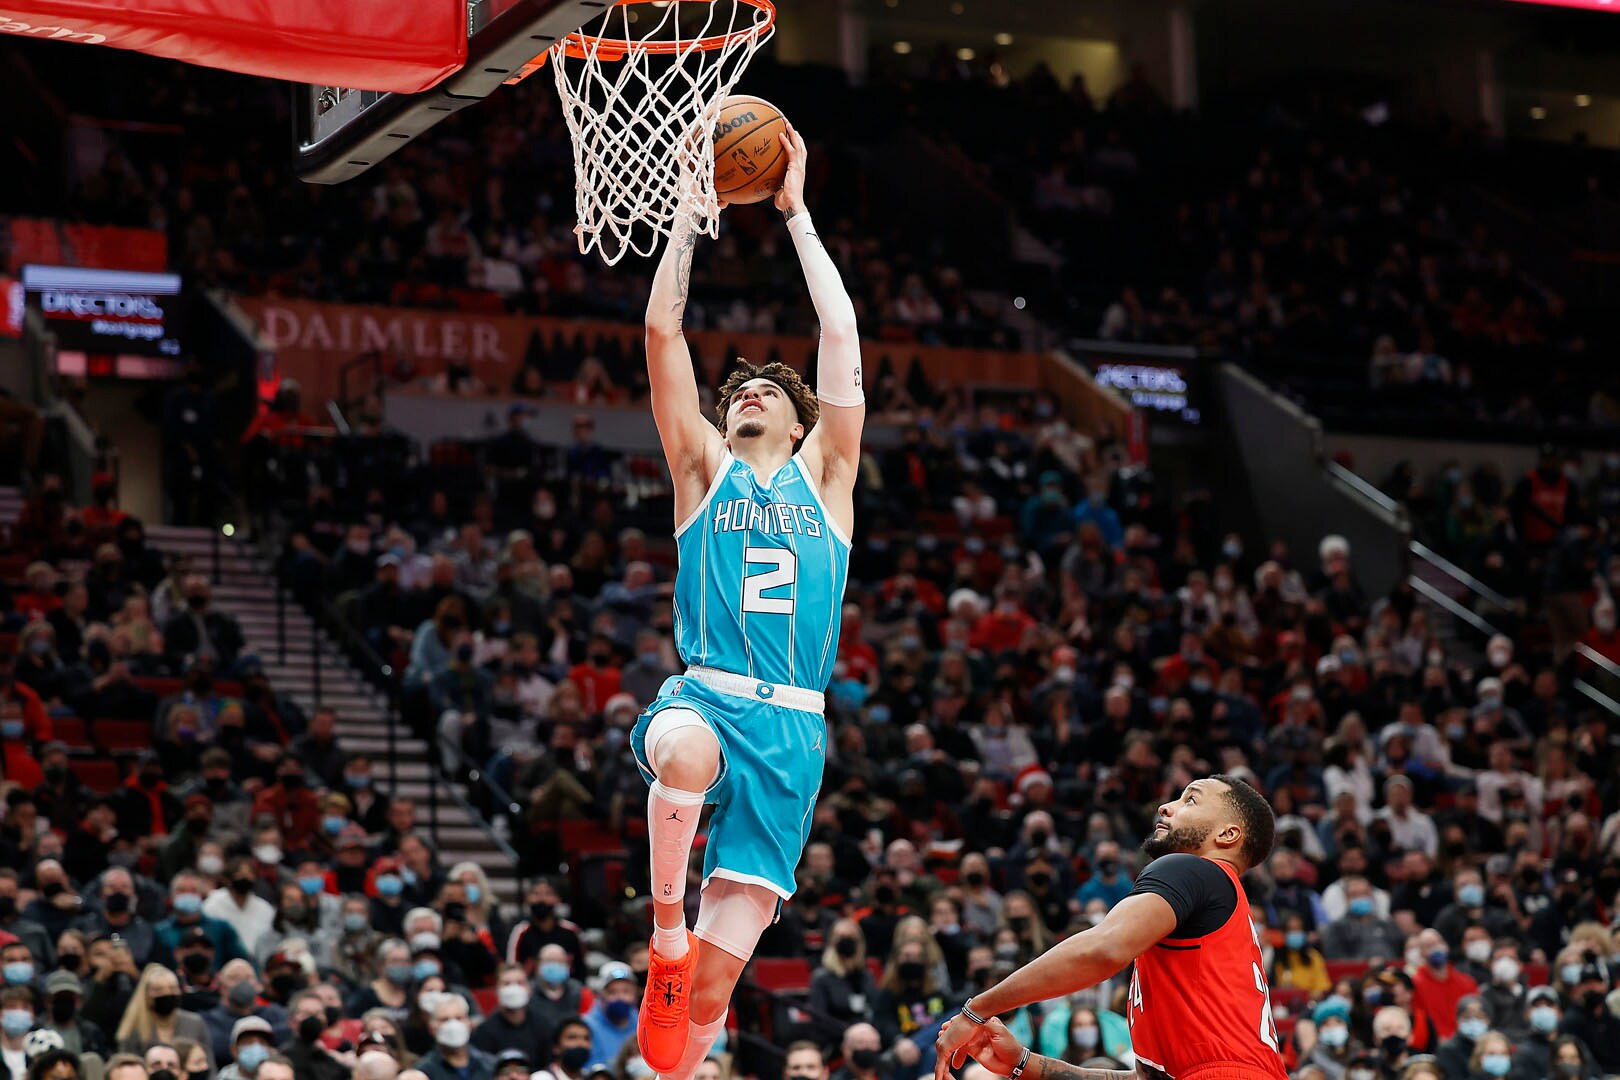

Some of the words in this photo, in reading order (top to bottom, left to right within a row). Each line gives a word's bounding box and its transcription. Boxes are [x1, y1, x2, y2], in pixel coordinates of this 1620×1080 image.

[712, 111, 758, 144] lson
[264, 307, 508, 363] DAIMLER
[713, 498, 822, 538] HORNETS
[742, 547, 797, 615] 2
